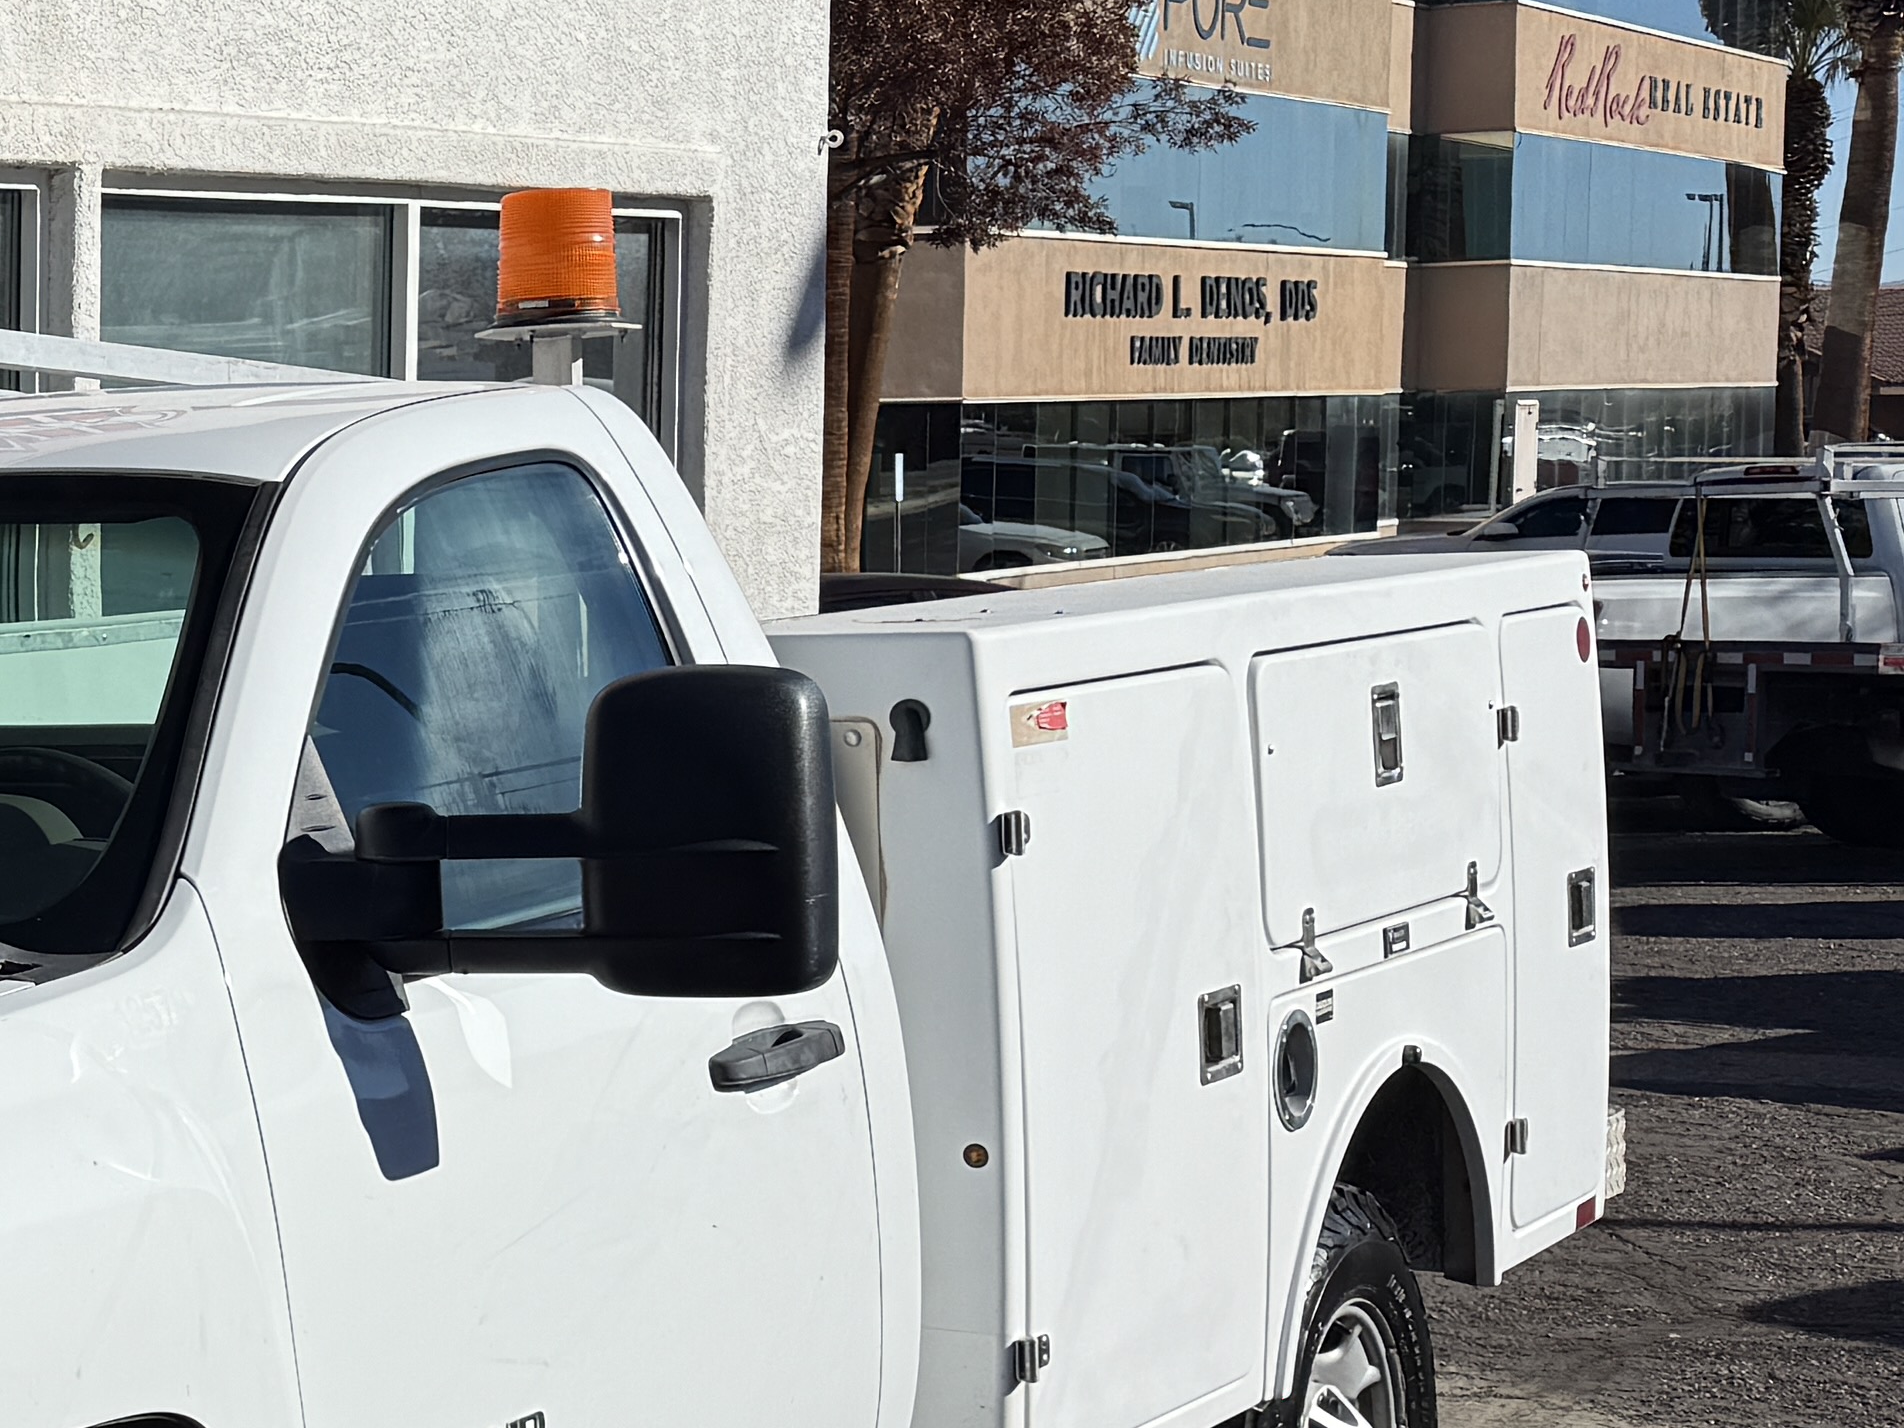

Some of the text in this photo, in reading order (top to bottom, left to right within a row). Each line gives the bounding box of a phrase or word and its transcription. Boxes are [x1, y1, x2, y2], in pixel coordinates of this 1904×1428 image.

[1163, 49, 1271, 82] INFUSION SUITES
[1649, 75, 1694, 116] REAL
[1702, 86, 1764, 128] ESTATE
[1064, 271, 1164, 318] RICHARD
[1172, 275, 1192, 318] L.
[1280, 279, 1318, 321] DDS
[1130, 336, 1259, 365] FAMILY DENTISTRY
